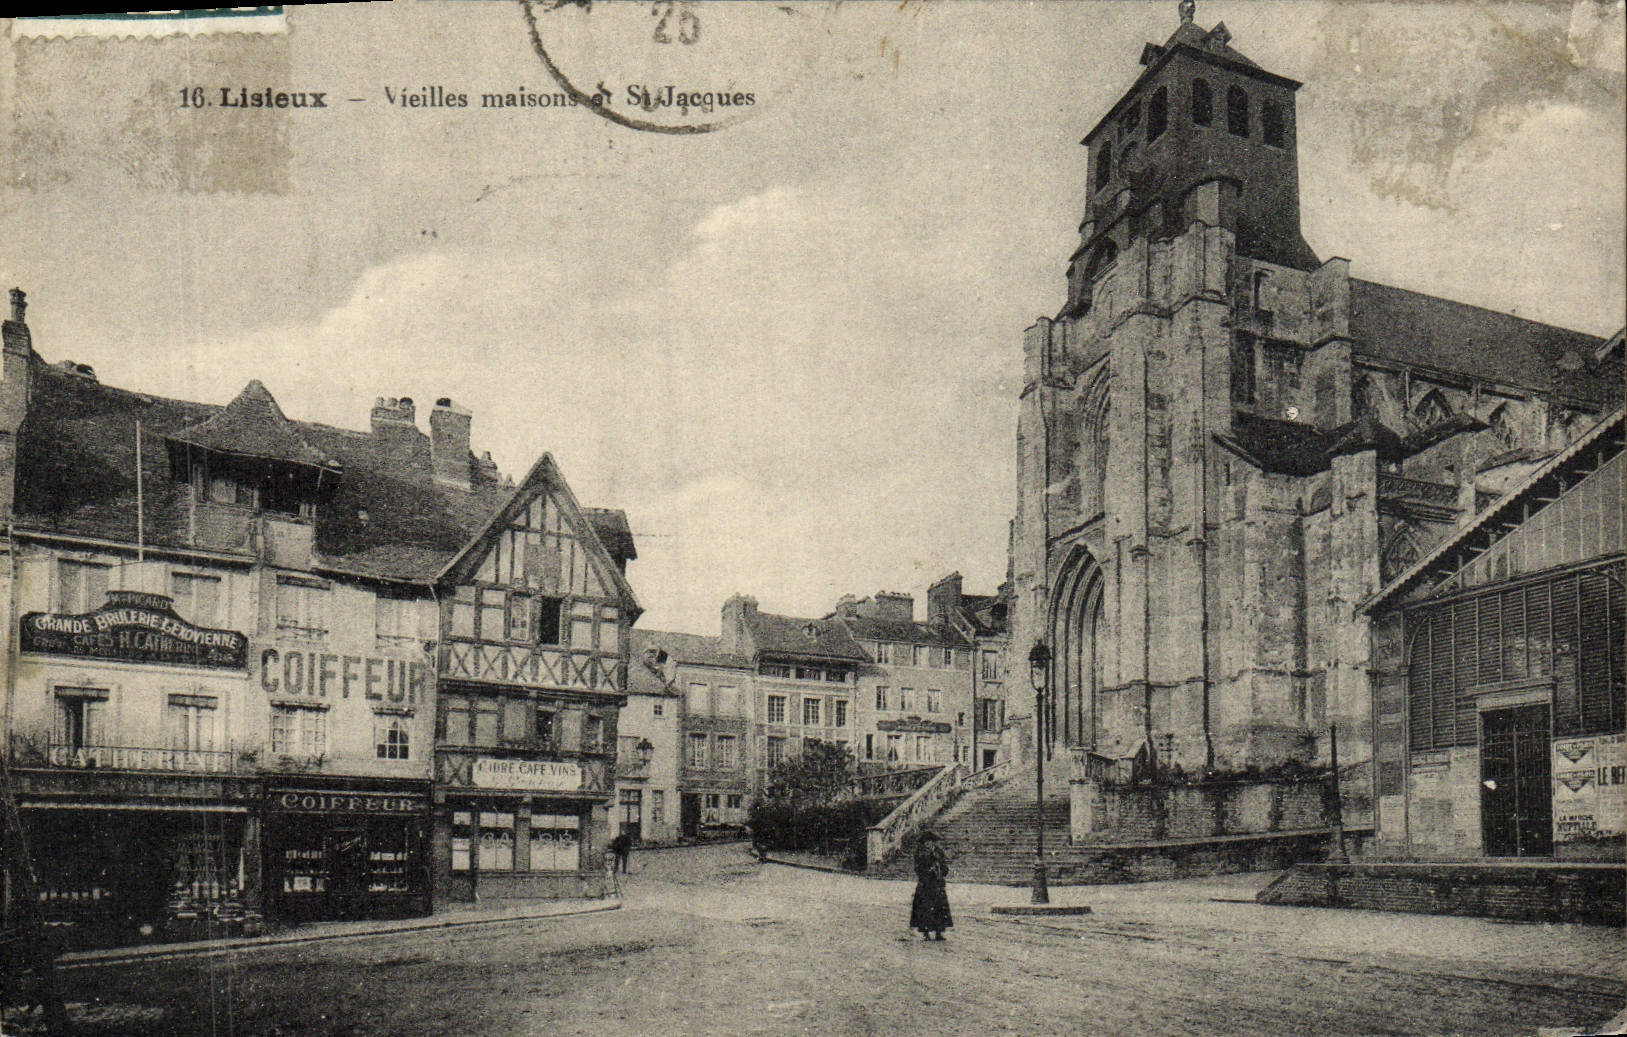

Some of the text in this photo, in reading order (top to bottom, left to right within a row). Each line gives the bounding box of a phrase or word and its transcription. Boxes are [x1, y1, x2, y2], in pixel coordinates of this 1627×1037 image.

[35, 614, 92, 634] GRANDE
[160, 617, 239, 649] LEXOVIENNE
[261, 648, 427, 704] COIFFEUR
[550, 763, 577, 777] VINS
[280, 792, 415, 812] COIFFEUR
